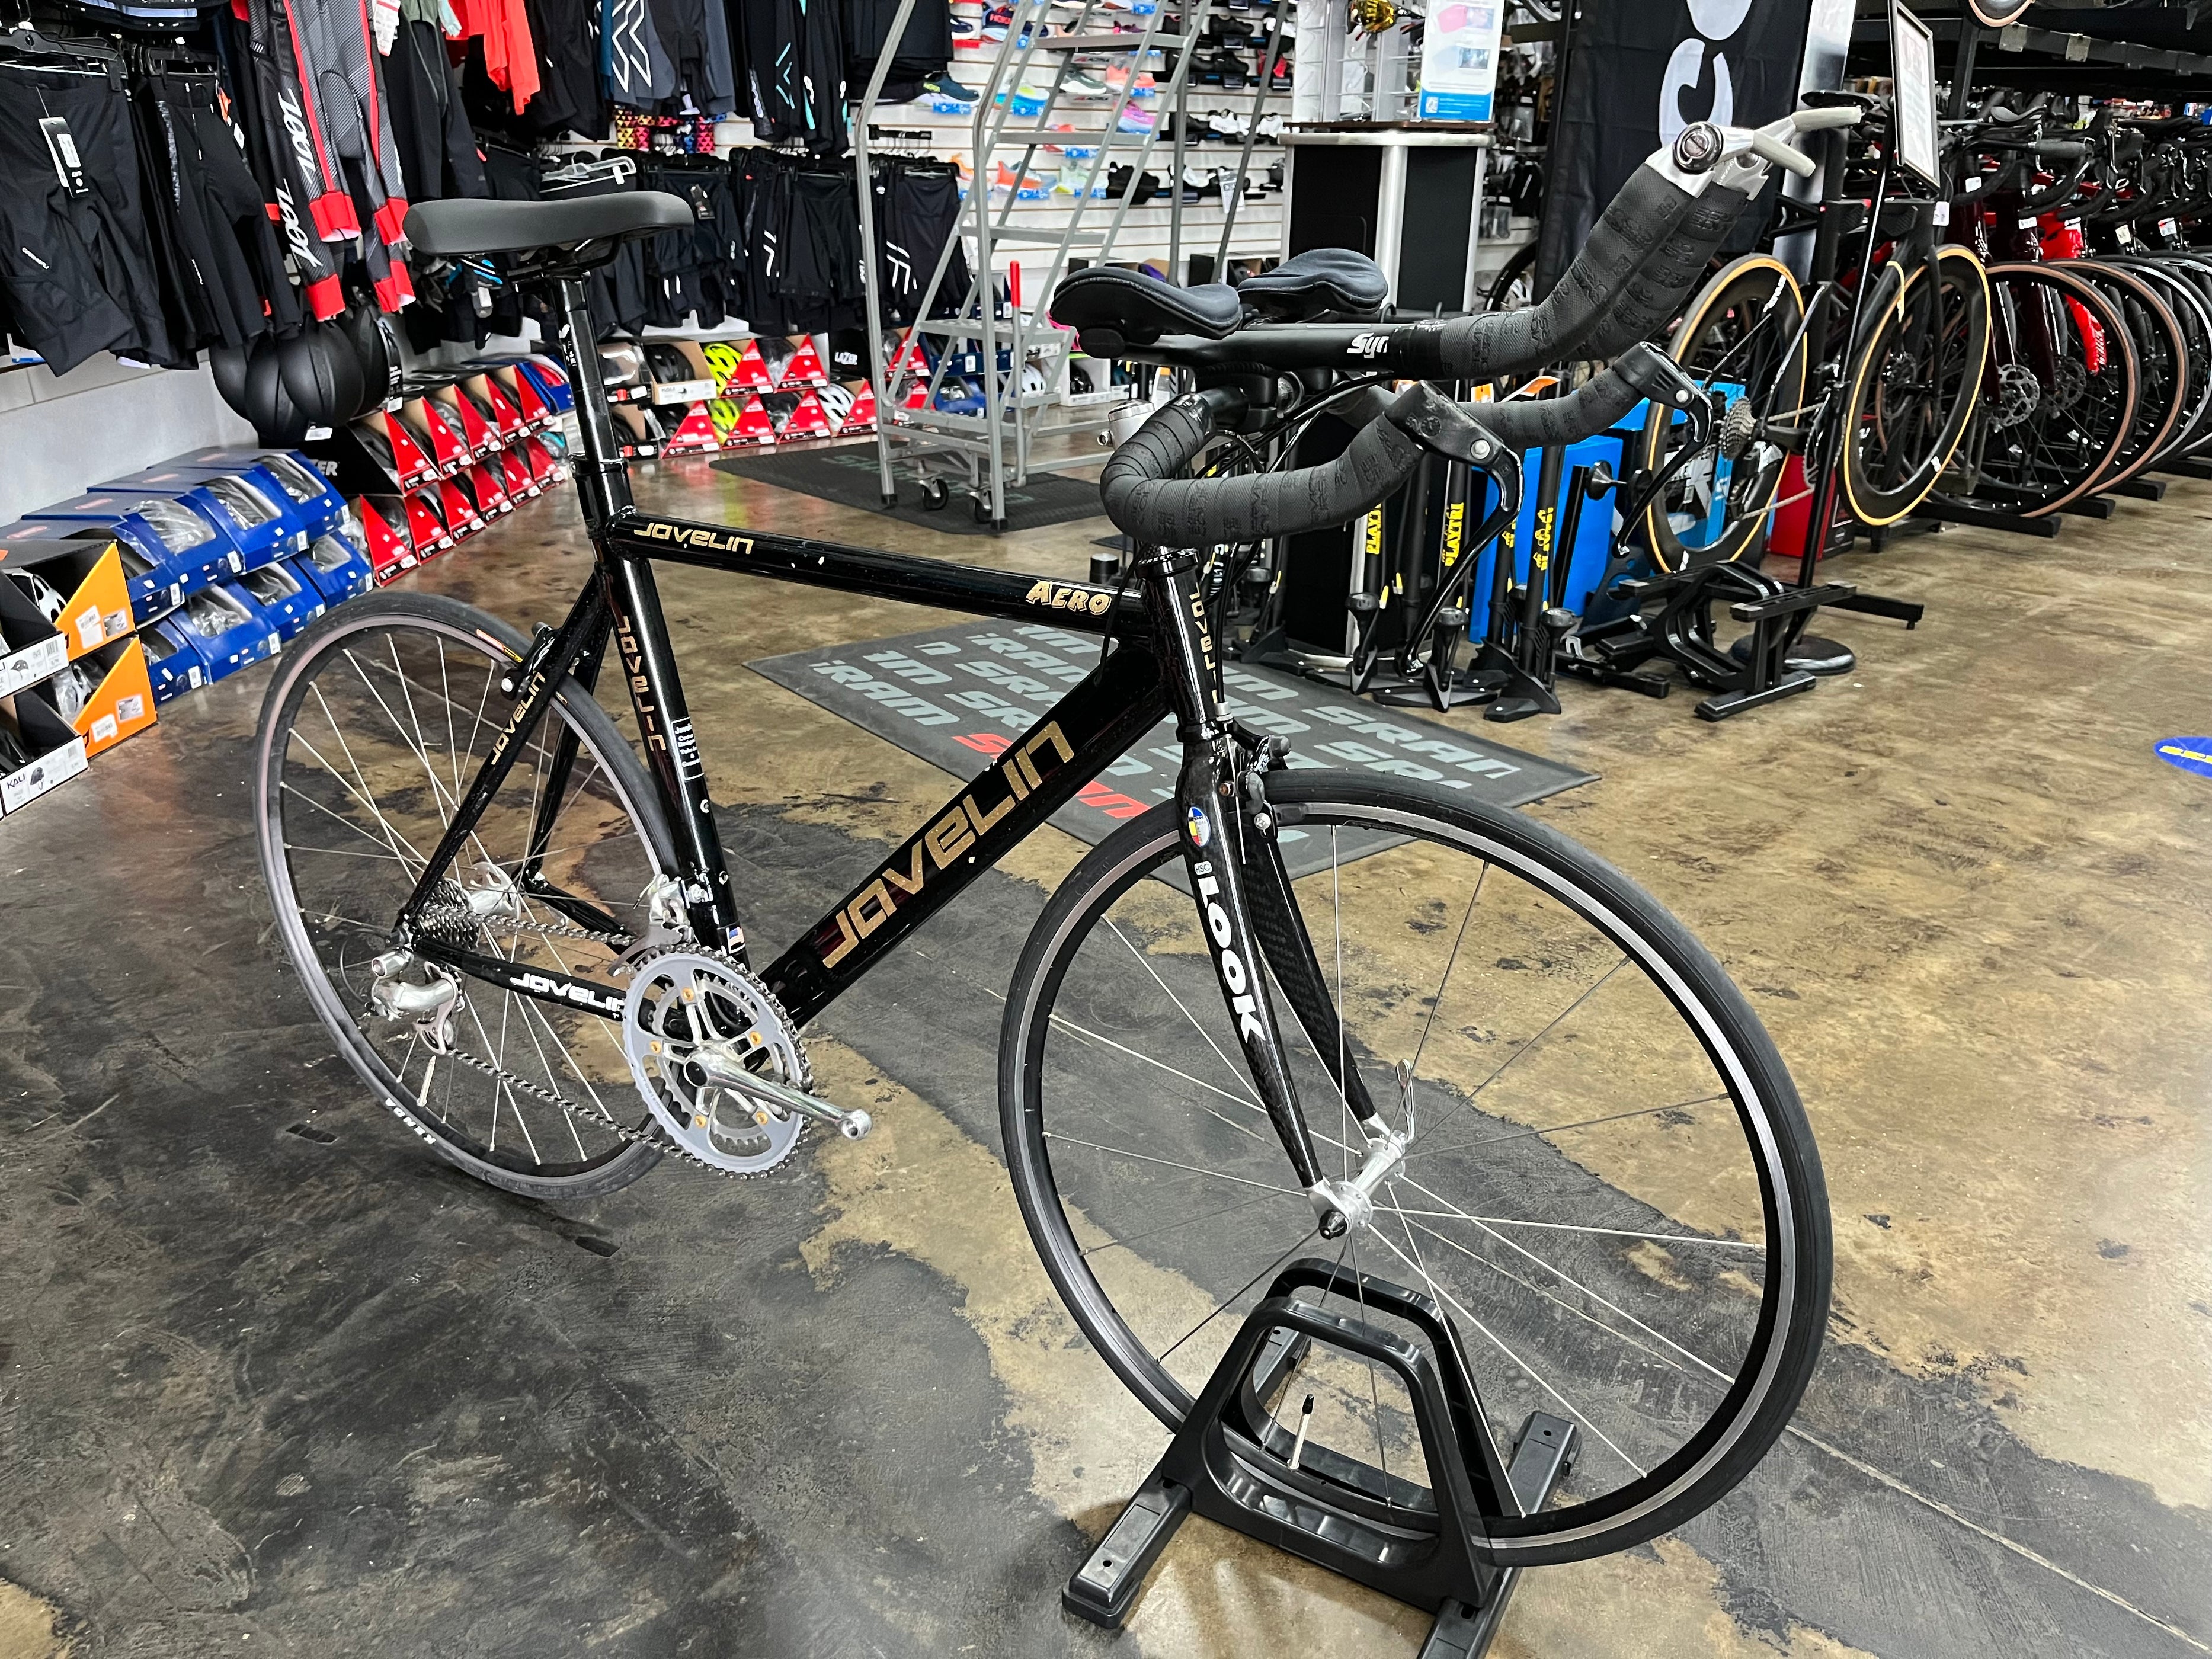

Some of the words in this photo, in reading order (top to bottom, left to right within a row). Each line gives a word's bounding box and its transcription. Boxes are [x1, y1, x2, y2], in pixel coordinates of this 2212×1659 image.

[834, 351, 858, 366] LAZER
[1025, 581, 1112, 616] AERO
[1195, 863, 1211, 873] HSC
[1198, 876, 1266, 1043] LOOK
[385, 1097, 437, 1144] KENDA
